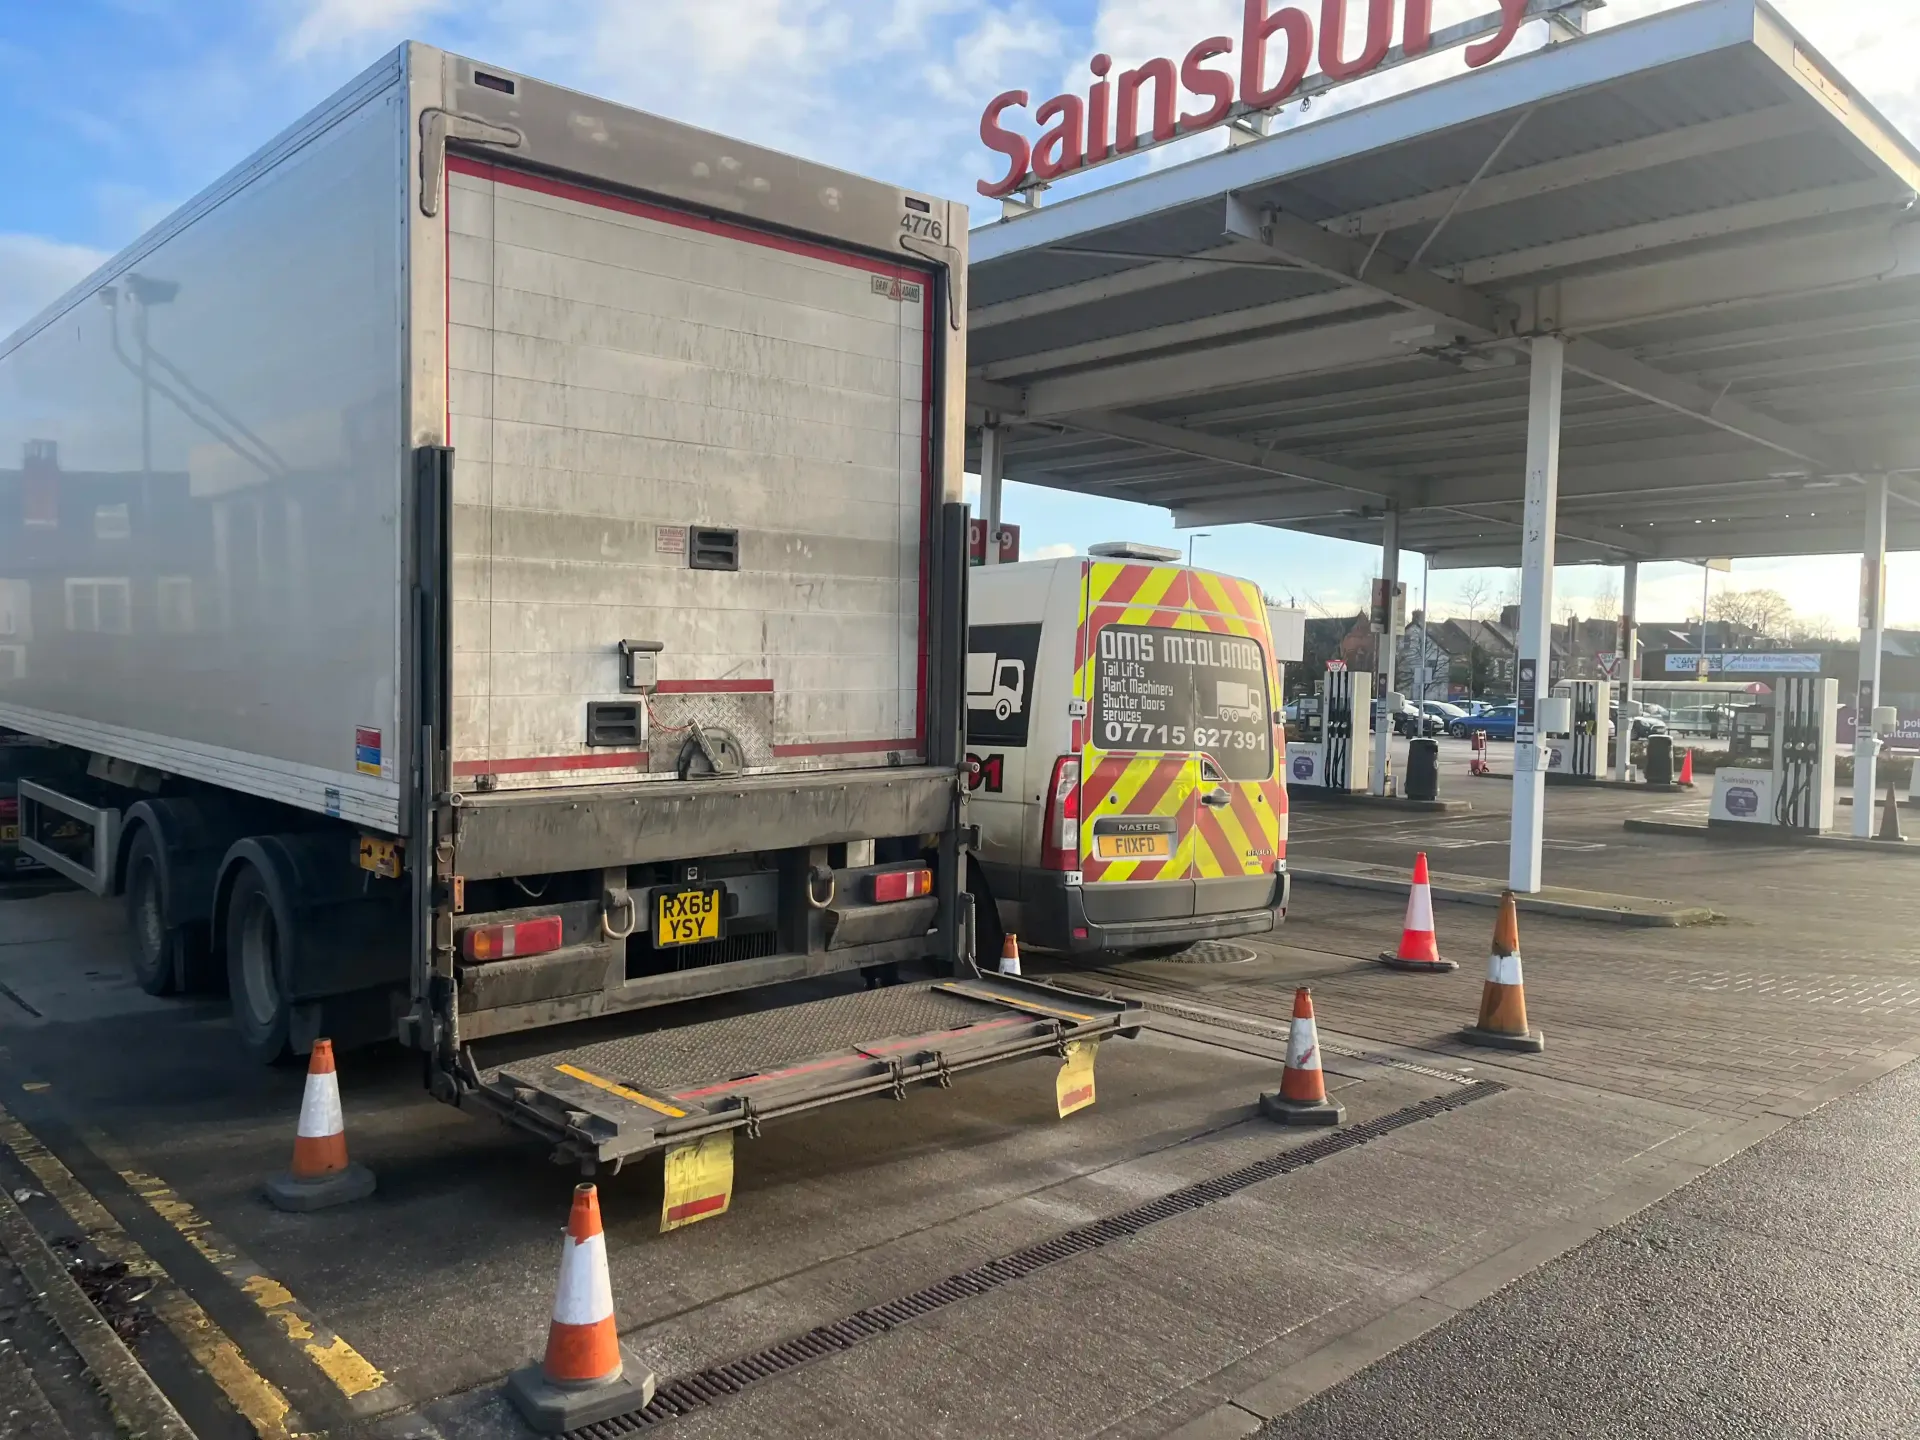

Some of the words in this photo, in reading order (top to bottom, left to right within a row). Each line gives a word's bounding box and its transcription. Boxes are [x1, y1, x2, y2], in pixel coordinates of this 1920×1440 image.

[900, 213, 942, 240] 4776
[1001, 531, 1013, 550] 9
[1100, 631, 1154, 661] DMS
[1163, 635, 1262, 671] MIDLANDS
[1102, 660, 1119, 676] Tail
[1121, 662, 1145, 678] Lifts
[1102, 676, 1126, 693] Plant
[1129, 678, 1174, 696] Machinery
[1102, 692, 1138, 709] Shutter
[1141, 695, 1165, 711] Doors
[1102, 709, 1142, 722] services
[1105, 721, 1186, 745] 07715
[1193, 727, 1266, 751] 627391
[1118, 823, 1160, 831] MASTER
[663, 893, 713, 919] RX68
[669, 916, 706, 940] YSY
